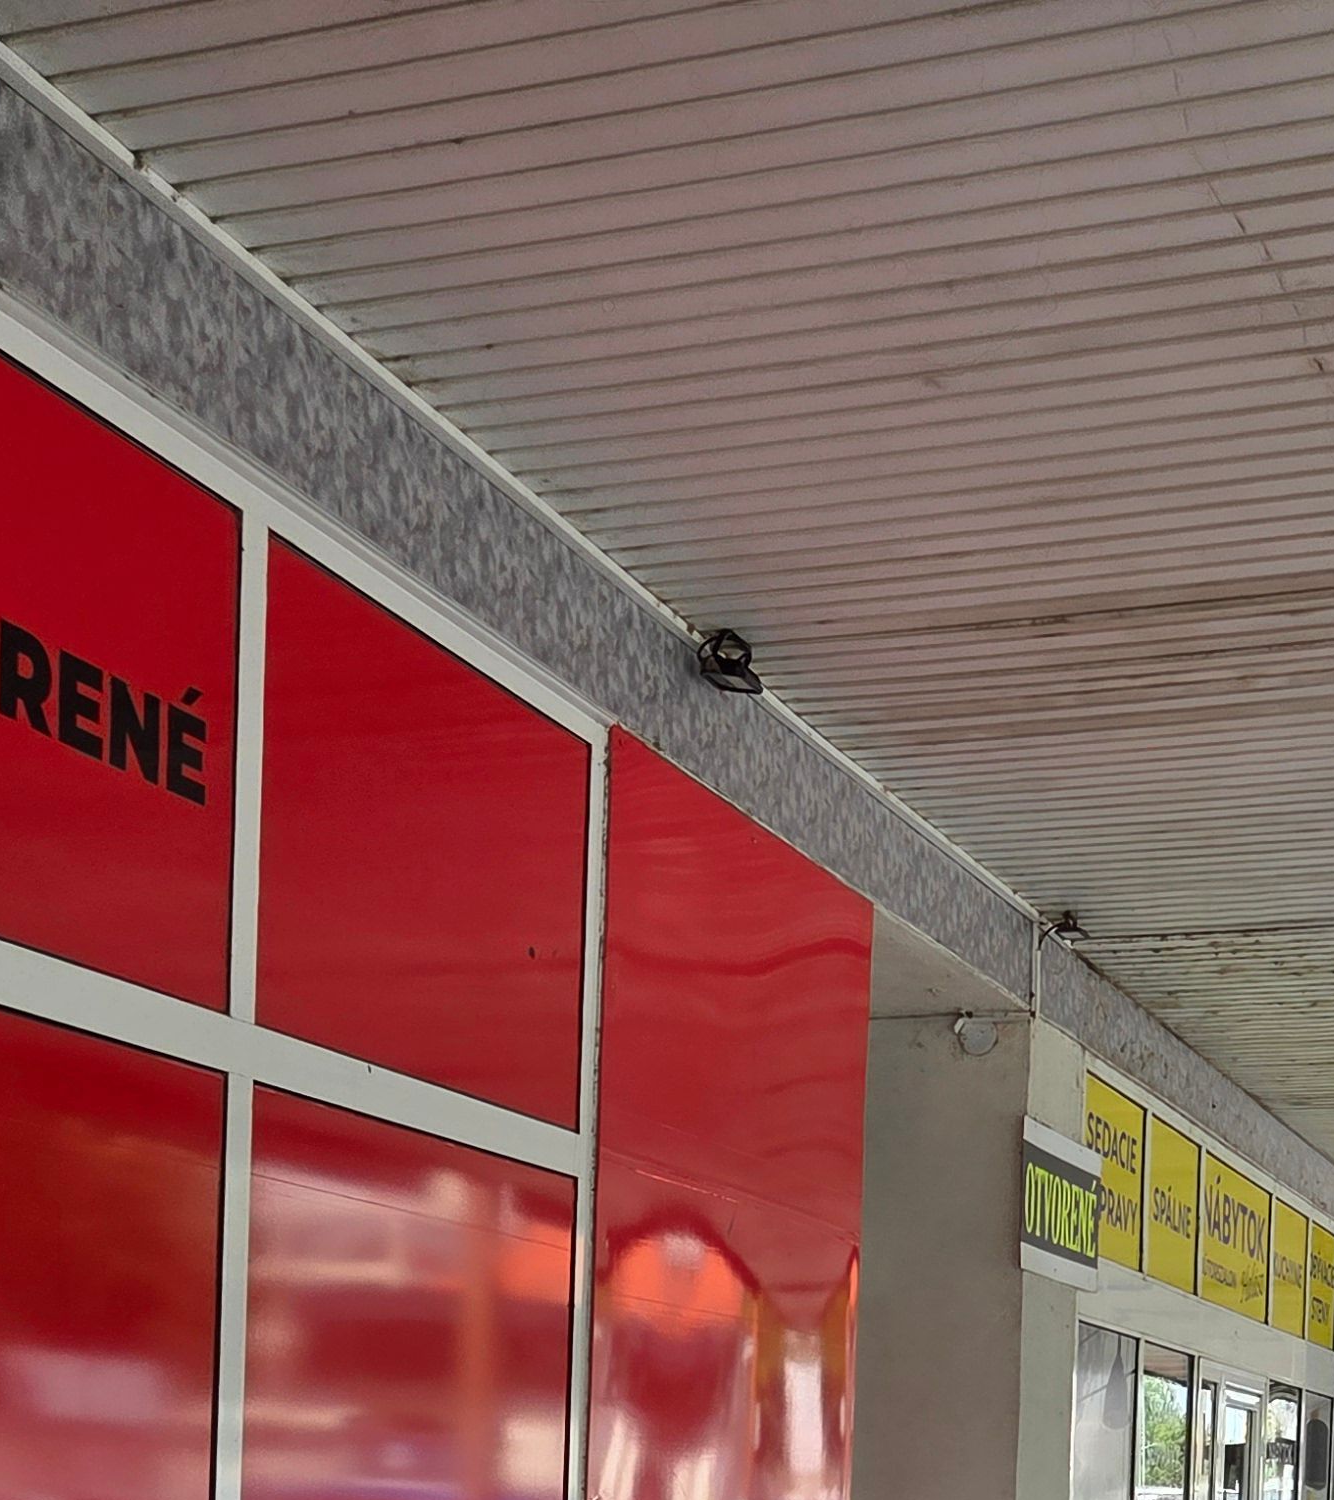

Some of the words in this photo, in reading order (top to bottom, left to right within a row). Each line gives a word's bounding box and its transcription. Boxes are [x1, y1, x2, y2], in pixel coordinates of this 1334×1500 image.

[1086, 1111, 1138, 1175] SEDACIE
[1024, 1162, 1098, 1259] OTVORENÉ
[1152, 1185, 1192, 1240] SPÁLNE
[1204, 1174, 1266, 1264] NÁBYTOK
